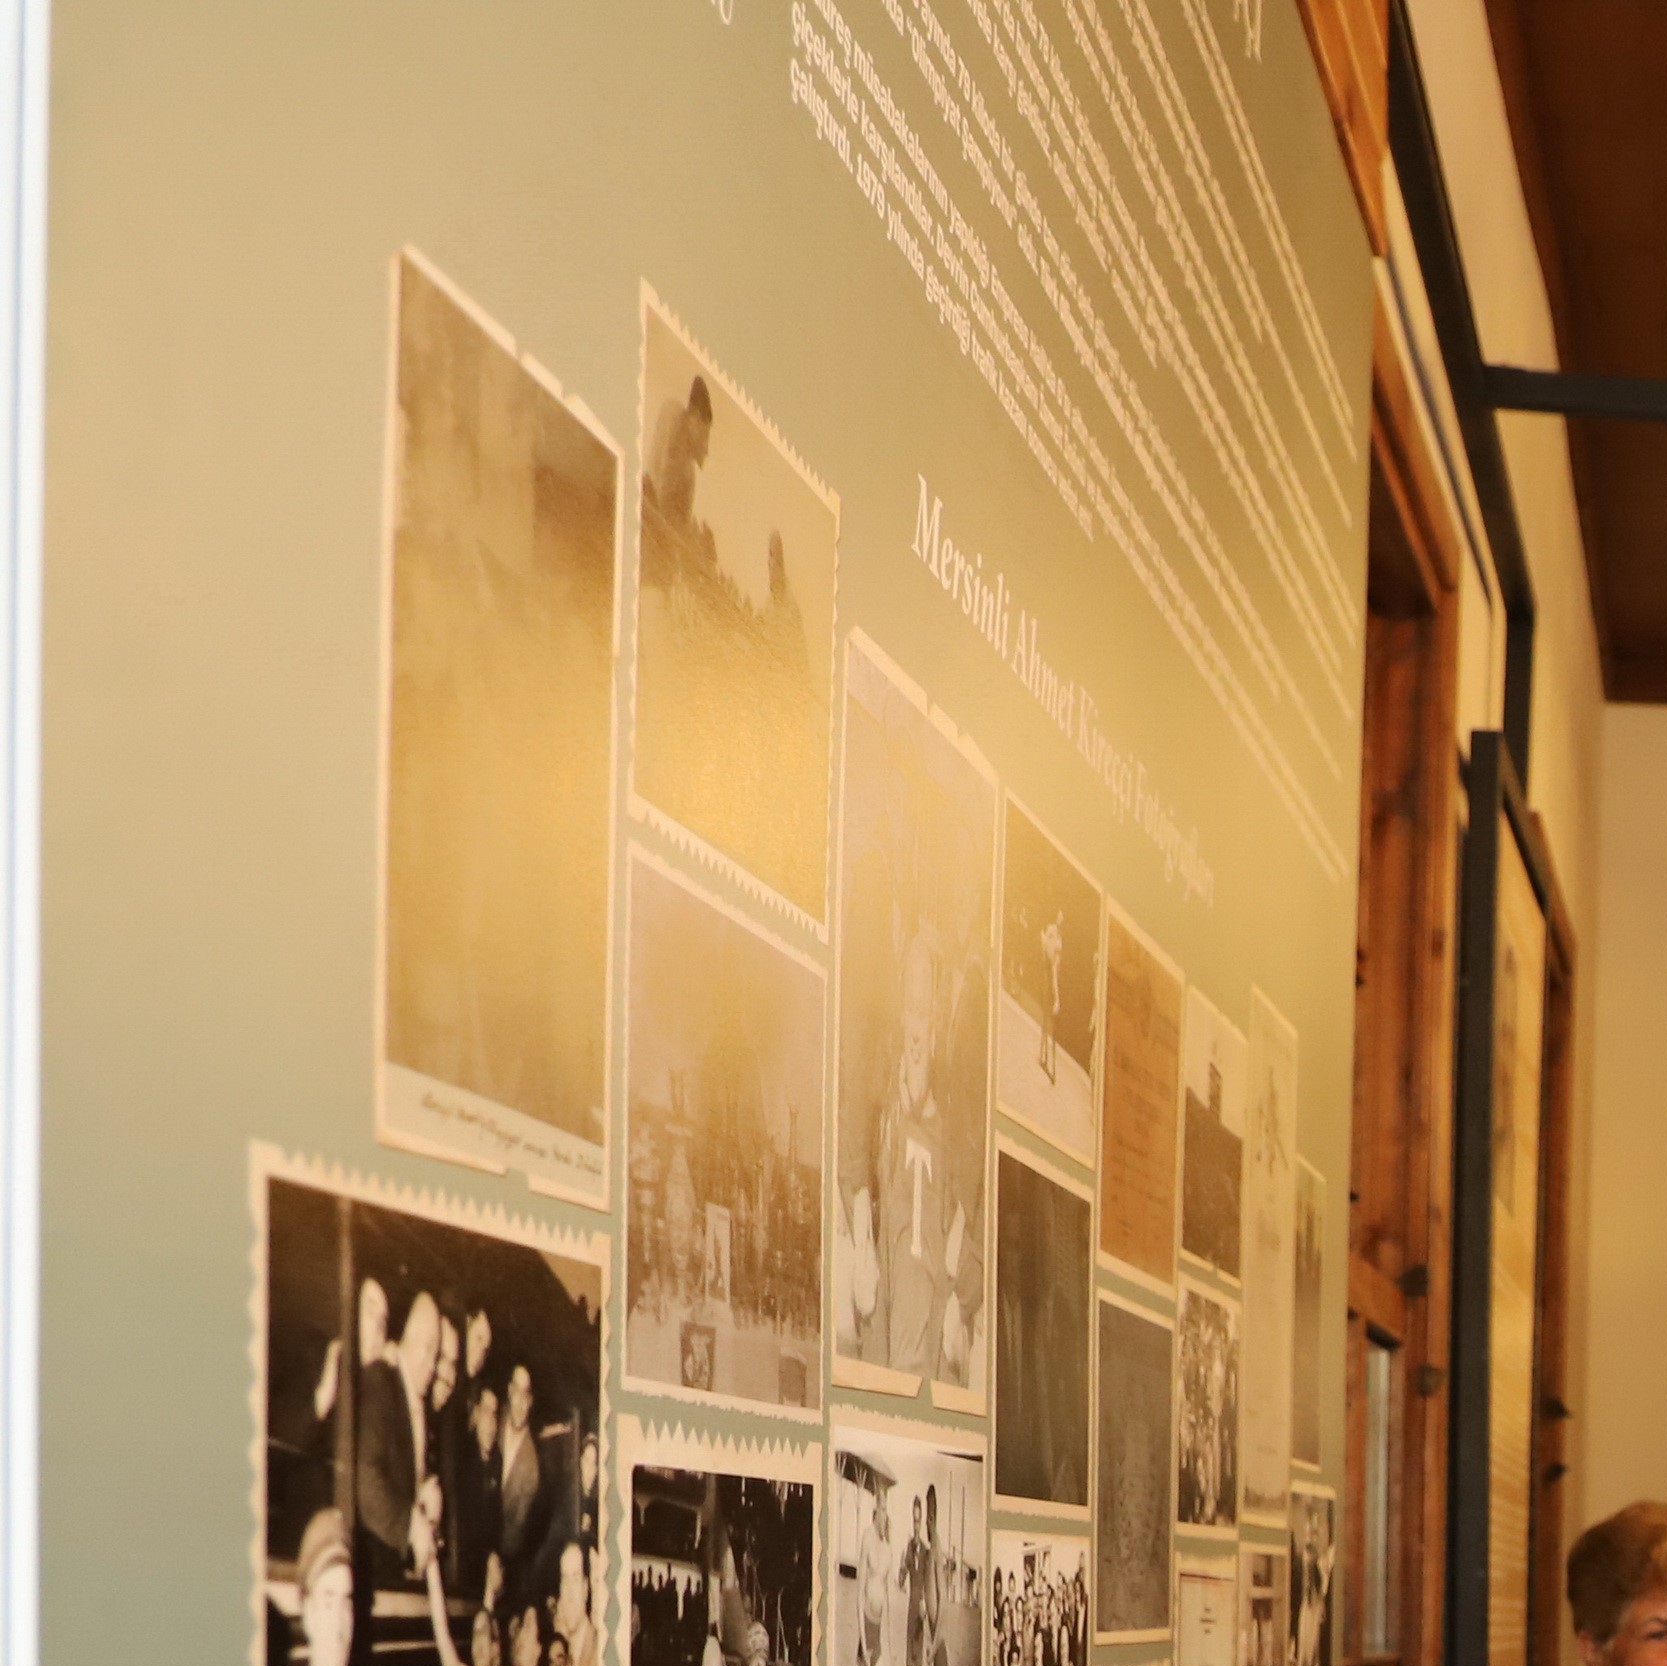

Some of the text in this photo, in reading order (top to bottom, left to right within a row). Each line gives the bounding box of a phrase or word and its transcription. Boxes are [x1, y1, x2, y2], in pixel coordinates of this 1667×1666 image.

[790, 58, 854, 174] çalıştırdı.
[856, 153, 885, 219] 1979
[886, 202, 925, 281] yılında
[925, 265, 971, 356] geçirdiği
[971, 329, 998, 394] trafik
[791, 0, 859, 124] çiçeklerle
[861, 99, 935, 246] karşılandılar.
[936, 223, 970, 300] Devrin
[853, 40, 948, 216] müsabakalarının
[948, 198, 990, 289] yapıldığı
[971, 80, 1001, 159] kiloda
[1001, 136, 1015, 182] bir
[911, 474, 1010, 660] Mersinli
[1010, 610, 1076, 739] Ahmet
[1076, 686, 1133, 824] Kireççi
[904, 1137, 933, 1259] T
